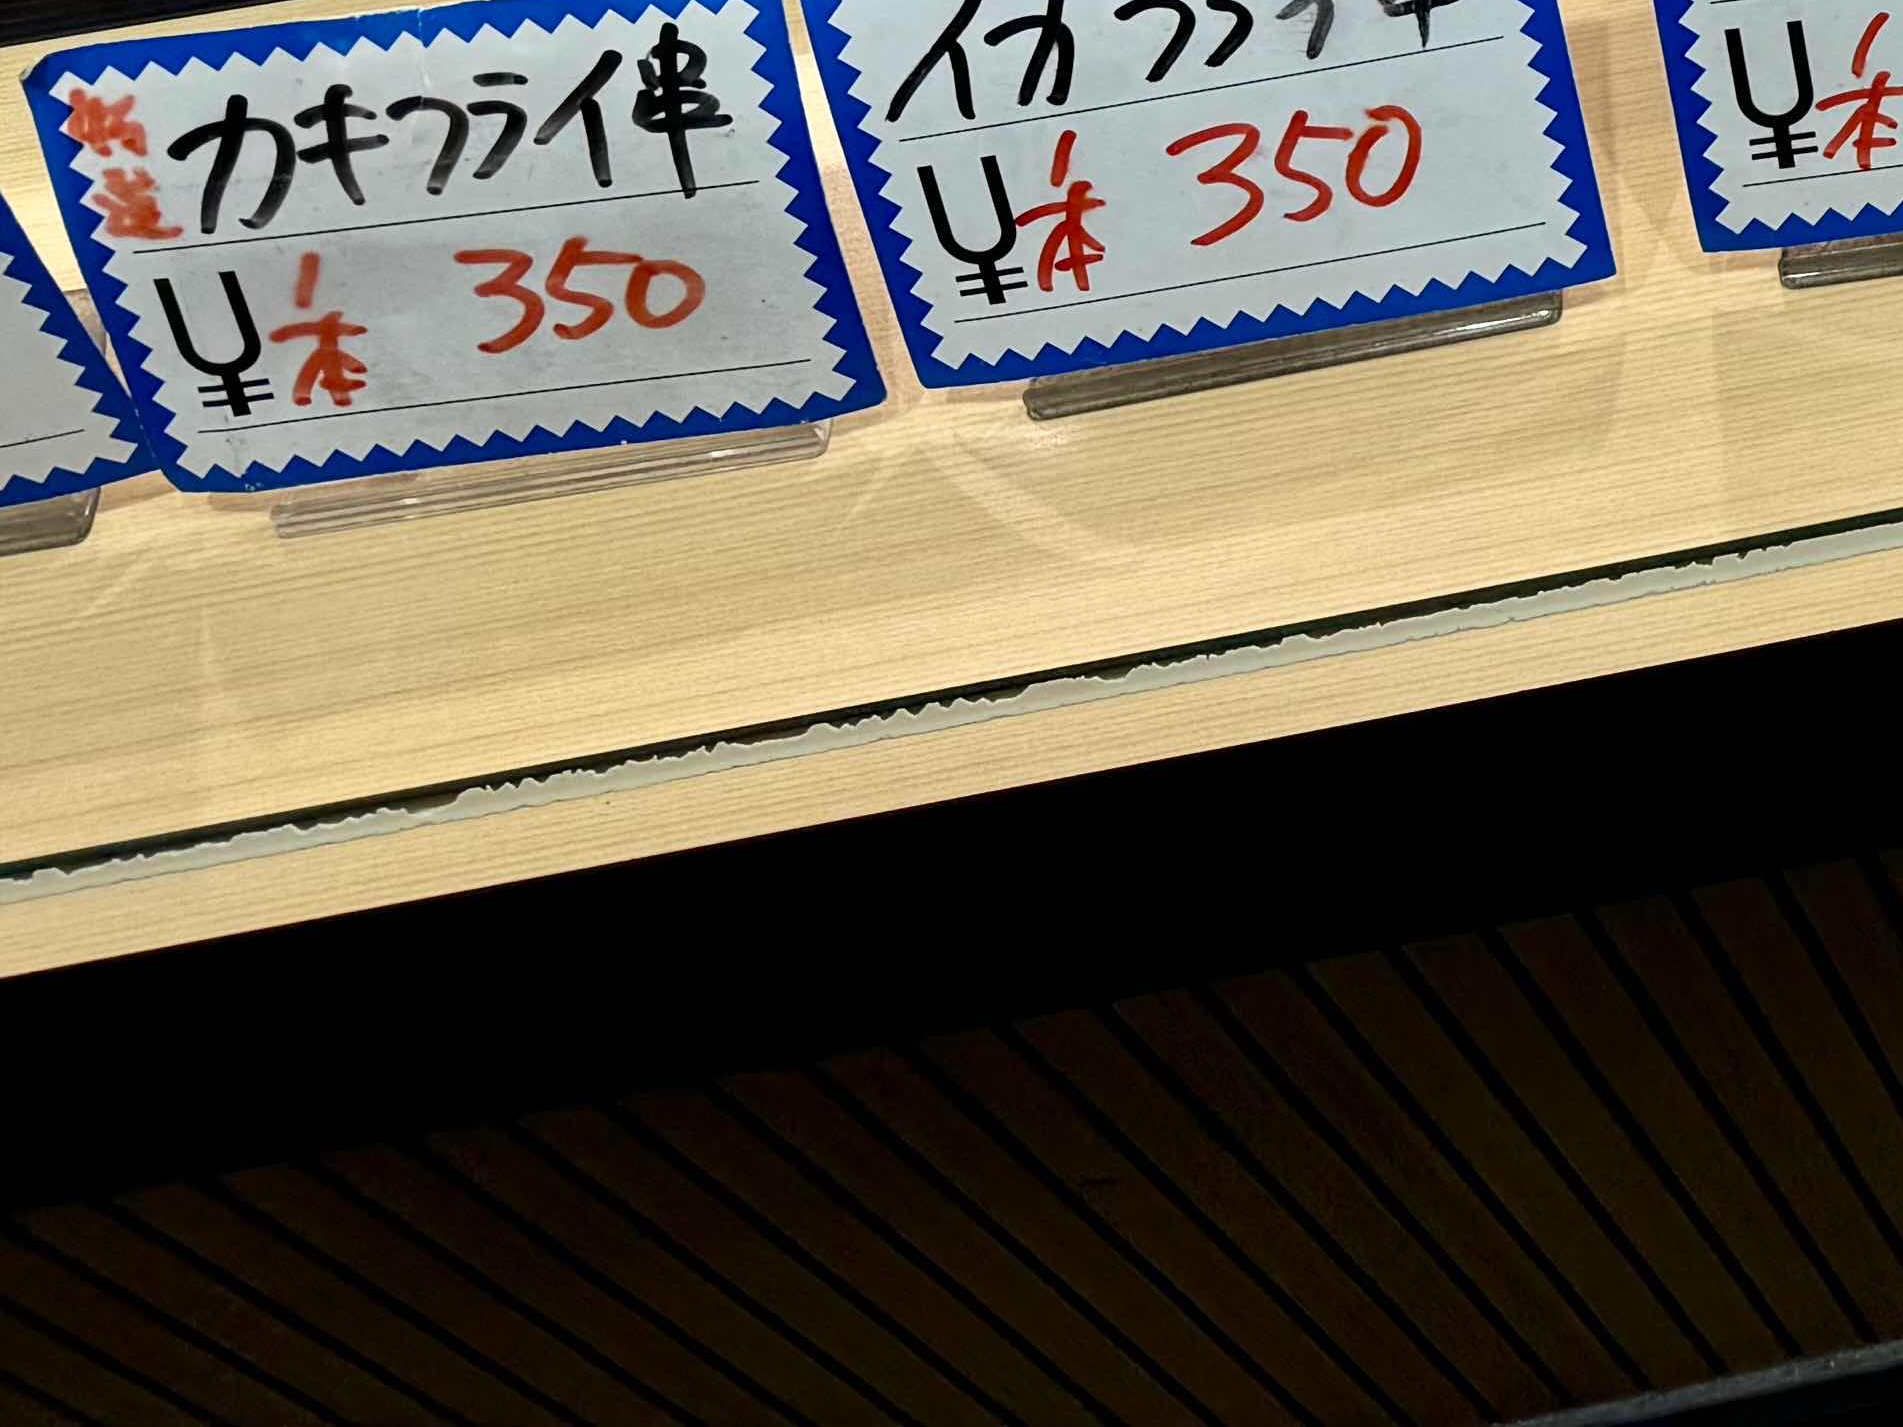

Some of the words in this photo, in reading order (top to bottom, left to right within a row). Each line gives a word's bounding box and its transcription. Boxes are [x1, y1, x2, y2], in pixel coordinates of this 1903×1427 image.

[166, 22, 733, 235] カキフライ串
[1166, 105, 1423, 246] 350
[452, 236, 706, 355] 350
